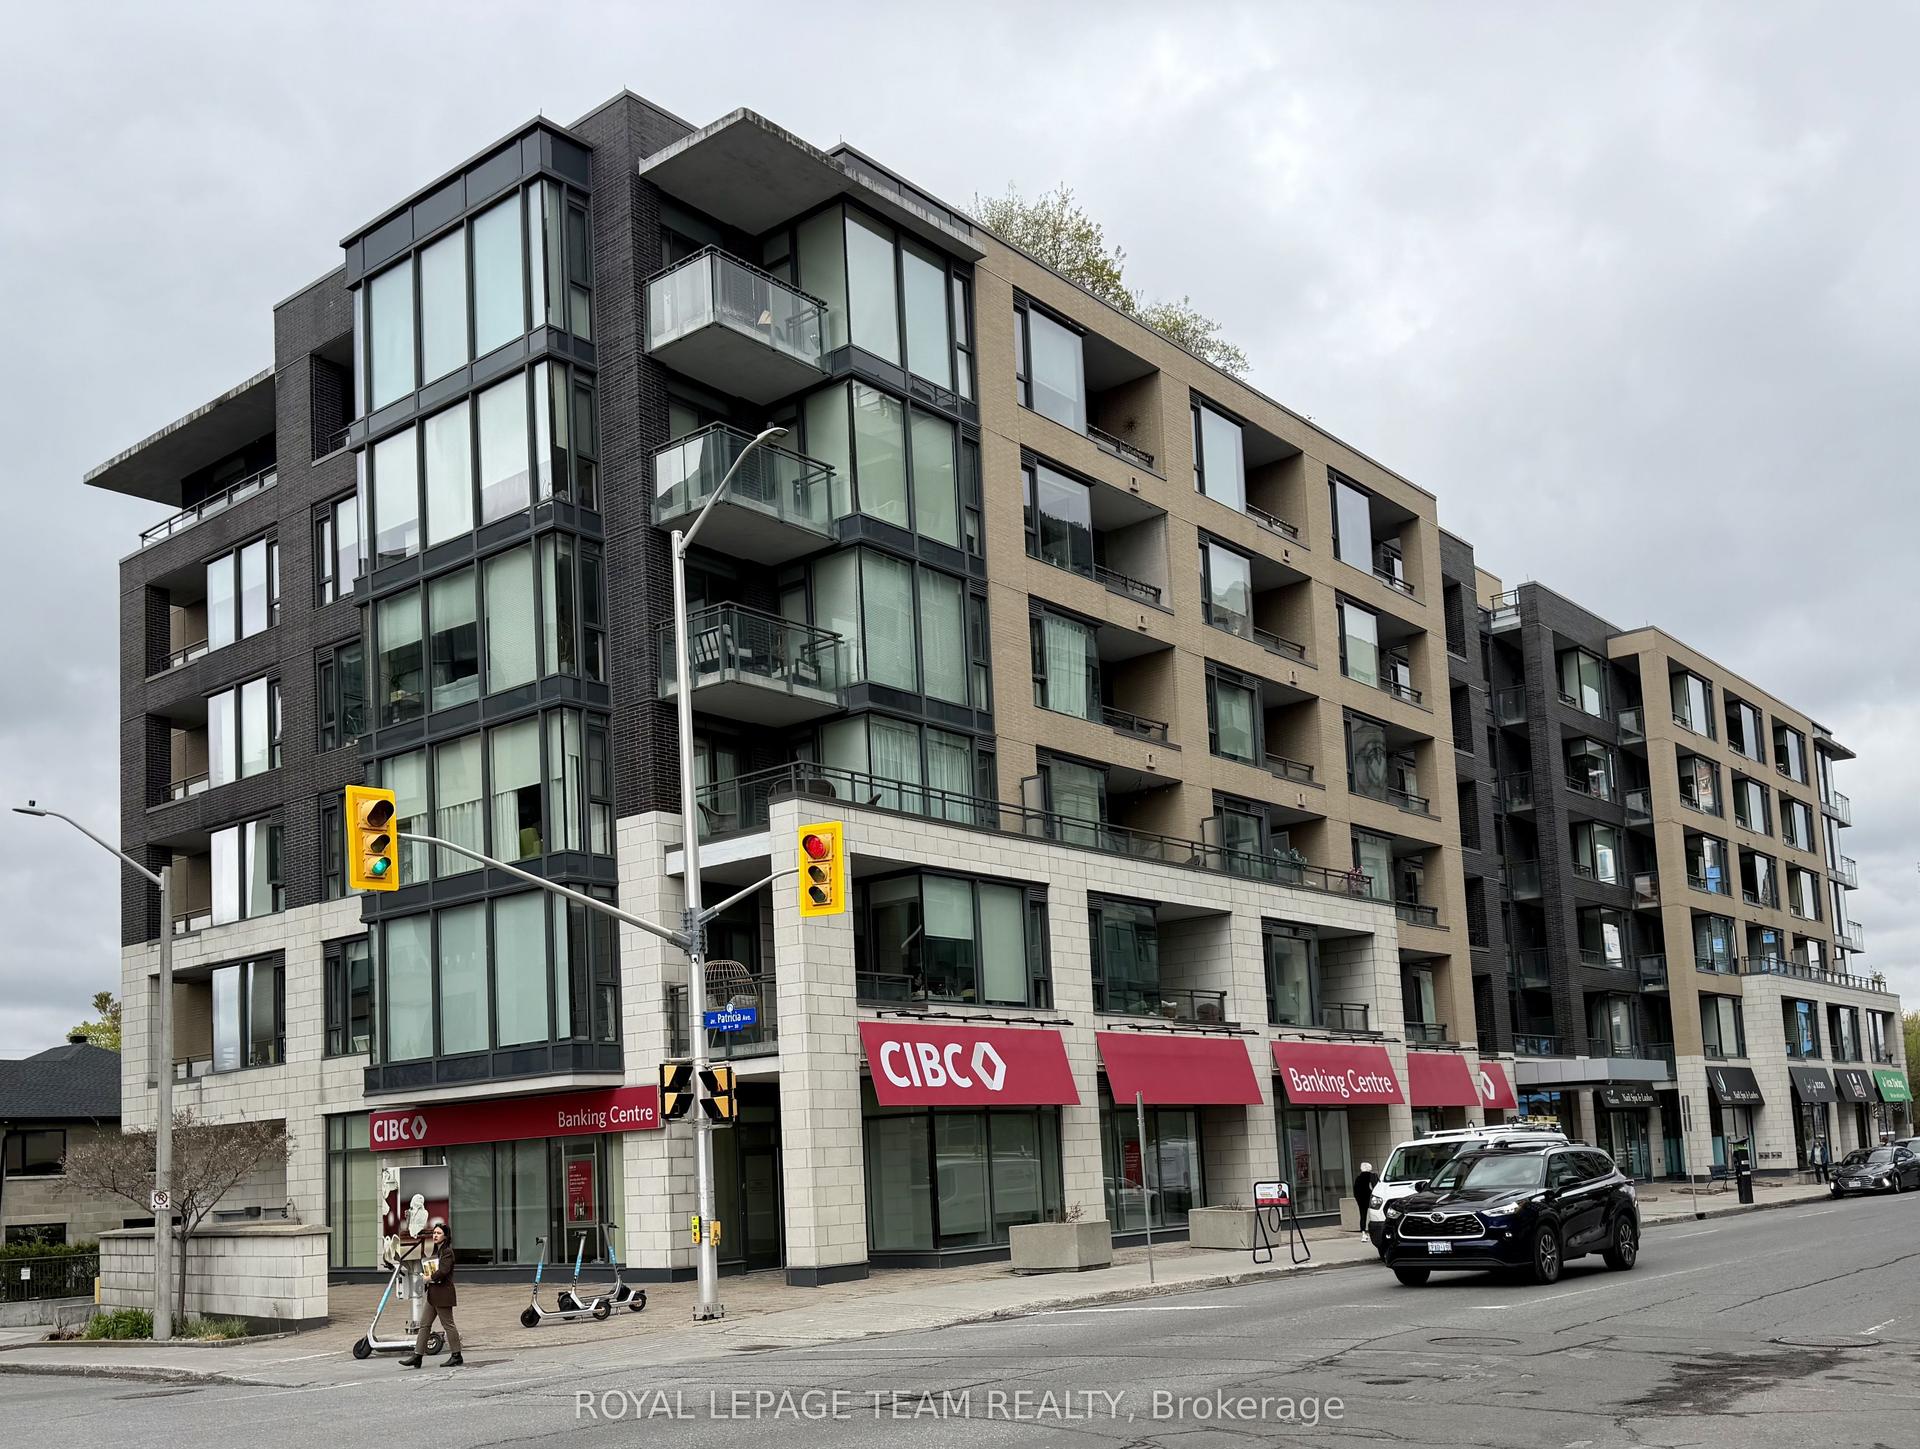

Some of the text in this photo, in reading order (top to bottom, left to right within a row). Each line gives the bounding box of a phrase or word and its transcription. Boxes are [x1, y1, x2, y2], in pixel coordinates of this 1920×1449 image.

[717, 1011, 741, 1023] Patricia
[879, 1040, 973, 1088] CIBC
[1288, 1067, 1394, 1098] Banking Centre
[558, 1105, 654, 1128] Banking Centre
[373, 1118, 410, 1143] CIBC
